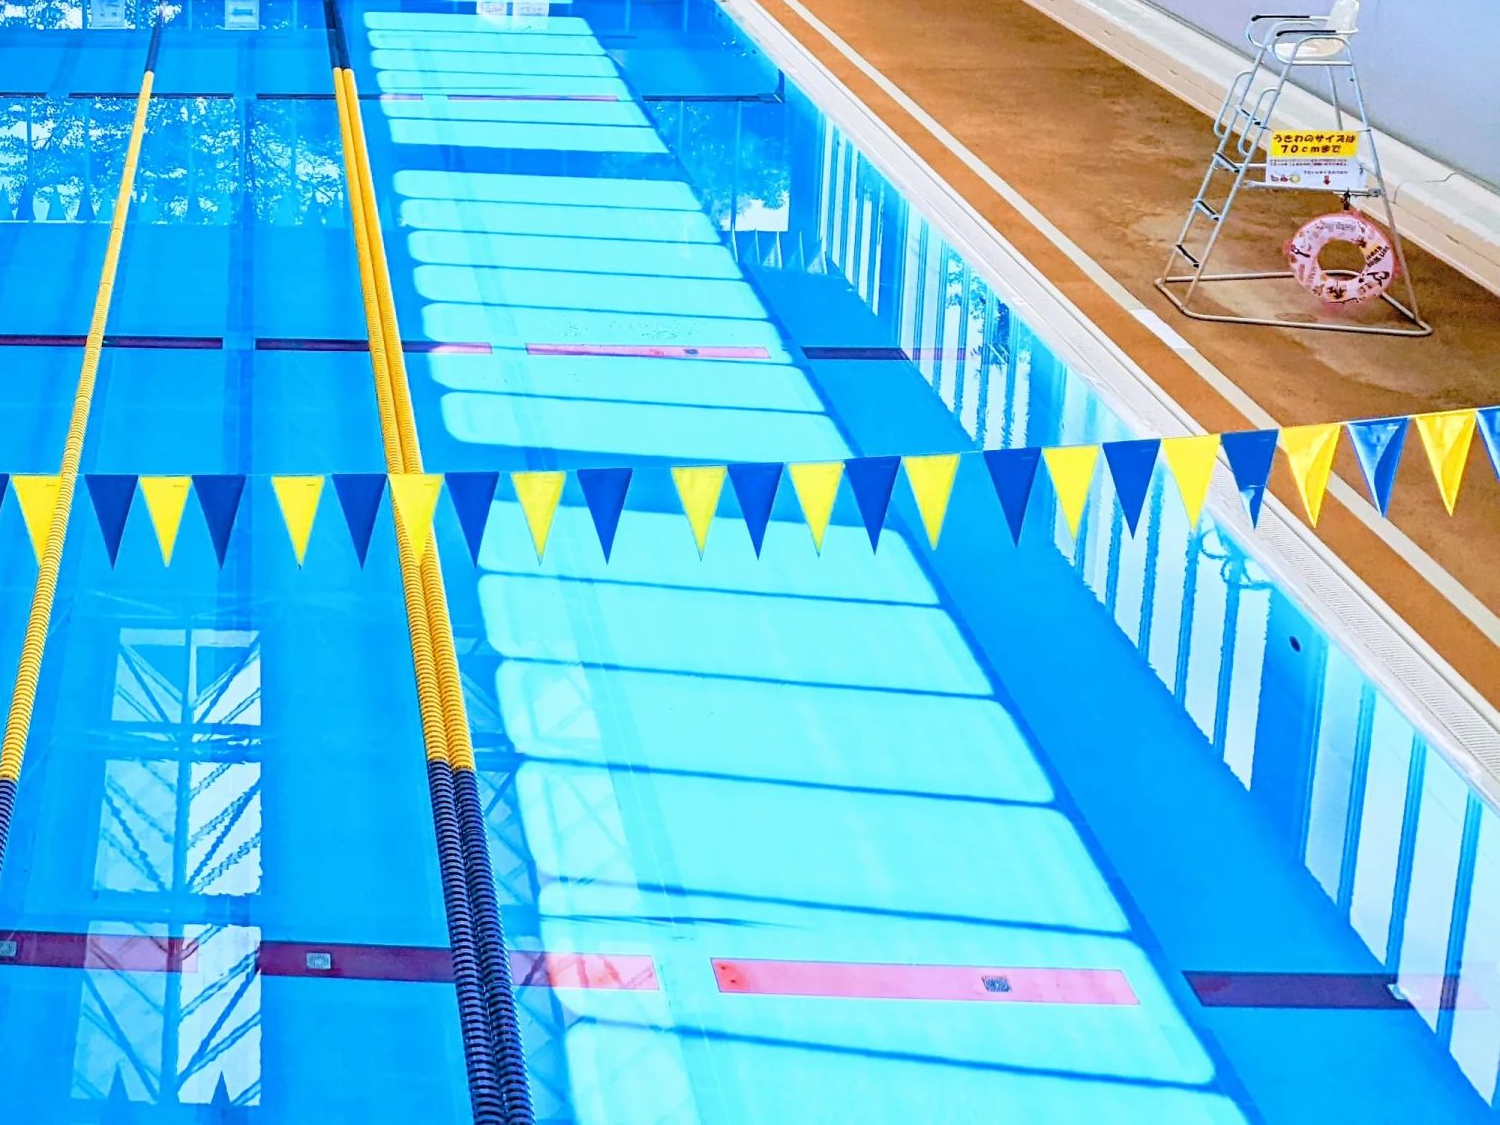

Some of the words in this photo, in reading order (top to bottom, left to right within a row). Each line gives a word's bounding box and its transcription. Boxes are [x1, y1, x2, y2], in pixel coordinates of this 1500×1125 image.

[1273, 134, 1356, 143] うきわのサイズは
